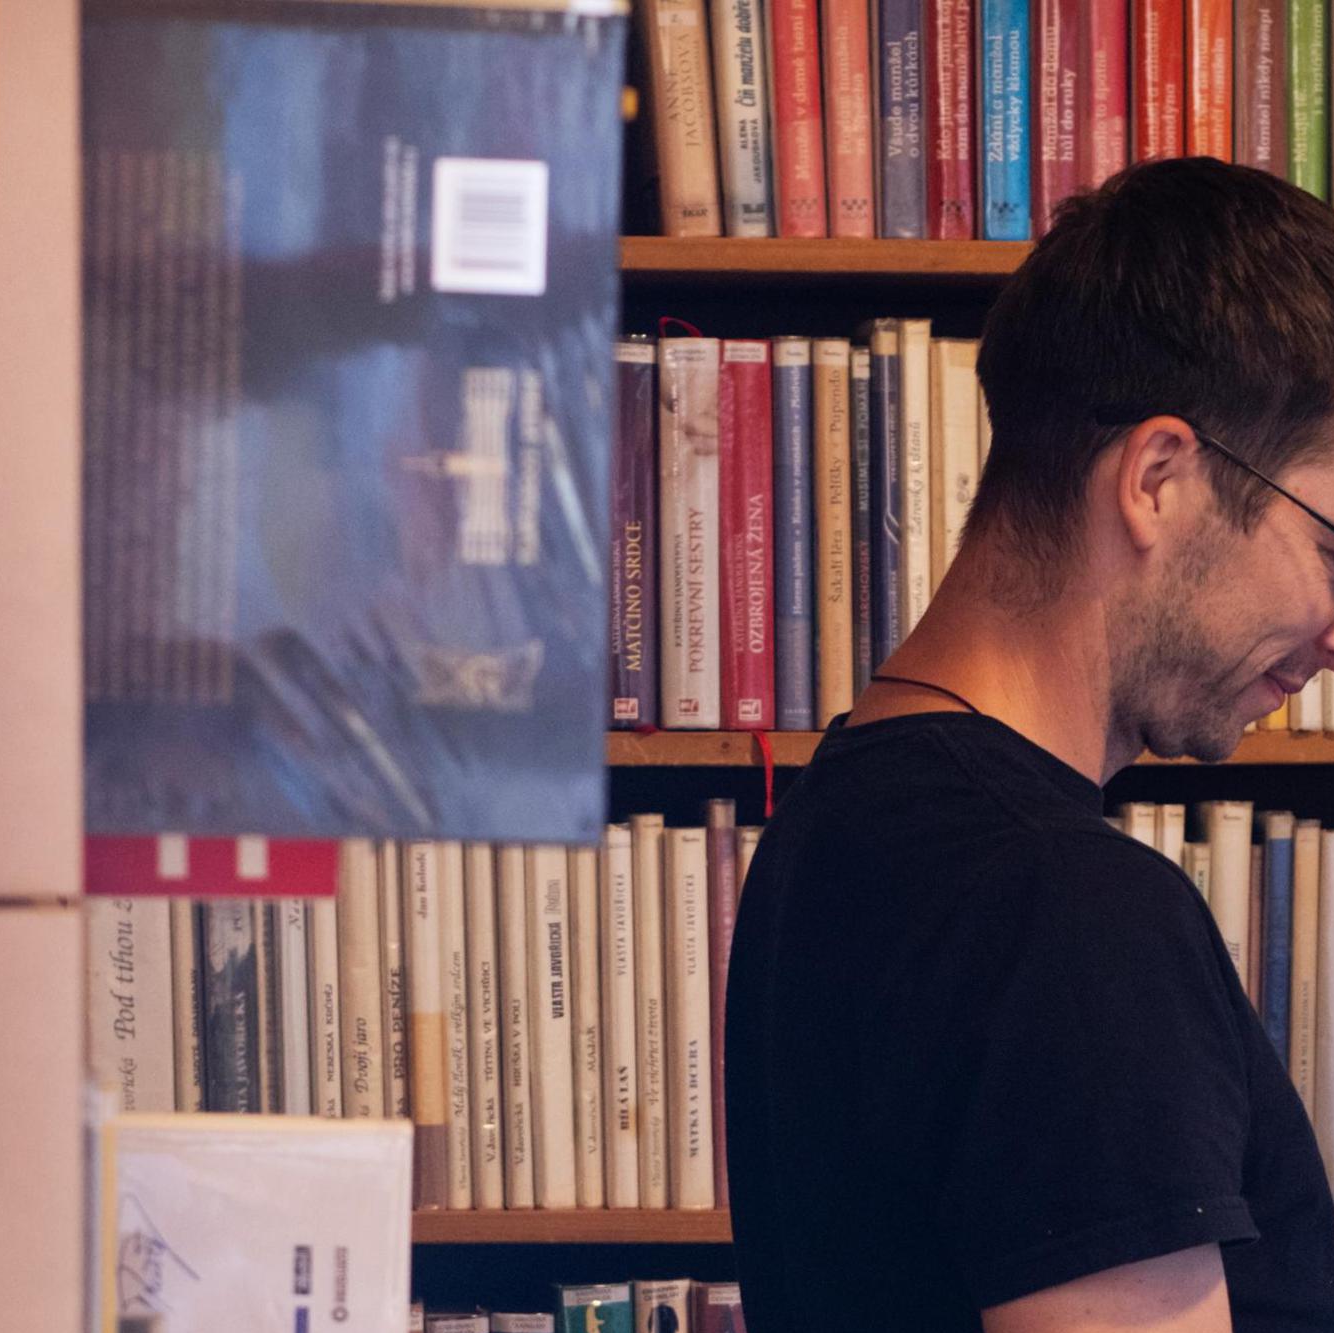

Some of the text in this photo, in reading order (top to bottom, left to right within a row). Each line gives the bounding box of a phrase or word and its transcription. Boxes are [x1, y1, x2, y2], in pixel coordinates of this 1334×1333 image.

[987, 36, 1003, 95] manžel
[1256, 56, 1273, 99] nikdy
[887, 42, 903, 157] Všude manžel
[907, 104, 919, 143] dvou
[911, 148, 919, 157] o
[1256, 105, 1271, 160] Manžel
[826, 369, 846, 603] Šakalí léta Pelíšky Pupendo
[621, 520, 643, 672] MATČINO SRDCE
[685, 507, 705, 673] POKREVNÍ SESTRY
[745, 492, 766, 654] OZBROJENÁ ŽENA
[615, 936, 628, 977] VLASTA
[683, 936, 697, 977] VLASTA
[109, 991, 136, 1042] Pod
[550, 979, 565, 1019] VLASTA
[323, 1032, 336, 1083] NEBESKÁ
[353, 1017, 373, 1095] Dvojí jaro
[688, 1108, 700, 1159] MATKA
